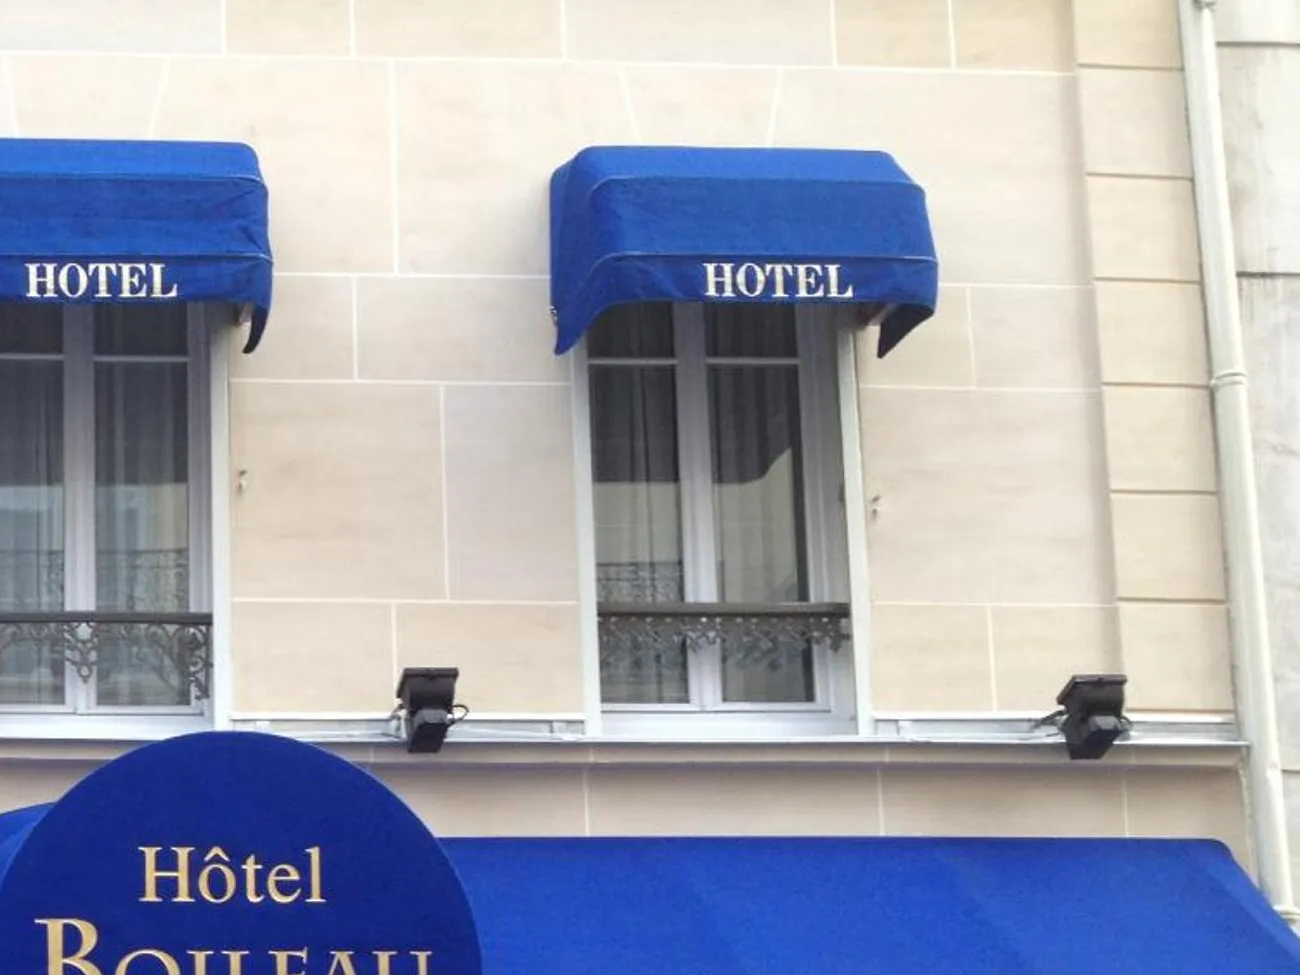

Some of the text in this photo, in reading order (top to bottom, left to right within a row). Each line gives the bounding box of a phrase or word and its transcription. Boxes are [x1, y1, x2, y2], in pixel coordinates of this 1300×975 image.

[25, 262, 177, 297] HOTEL
[702, 262, 853, 297] HOTEL
[138, 846, 327, 904] Hôtel
